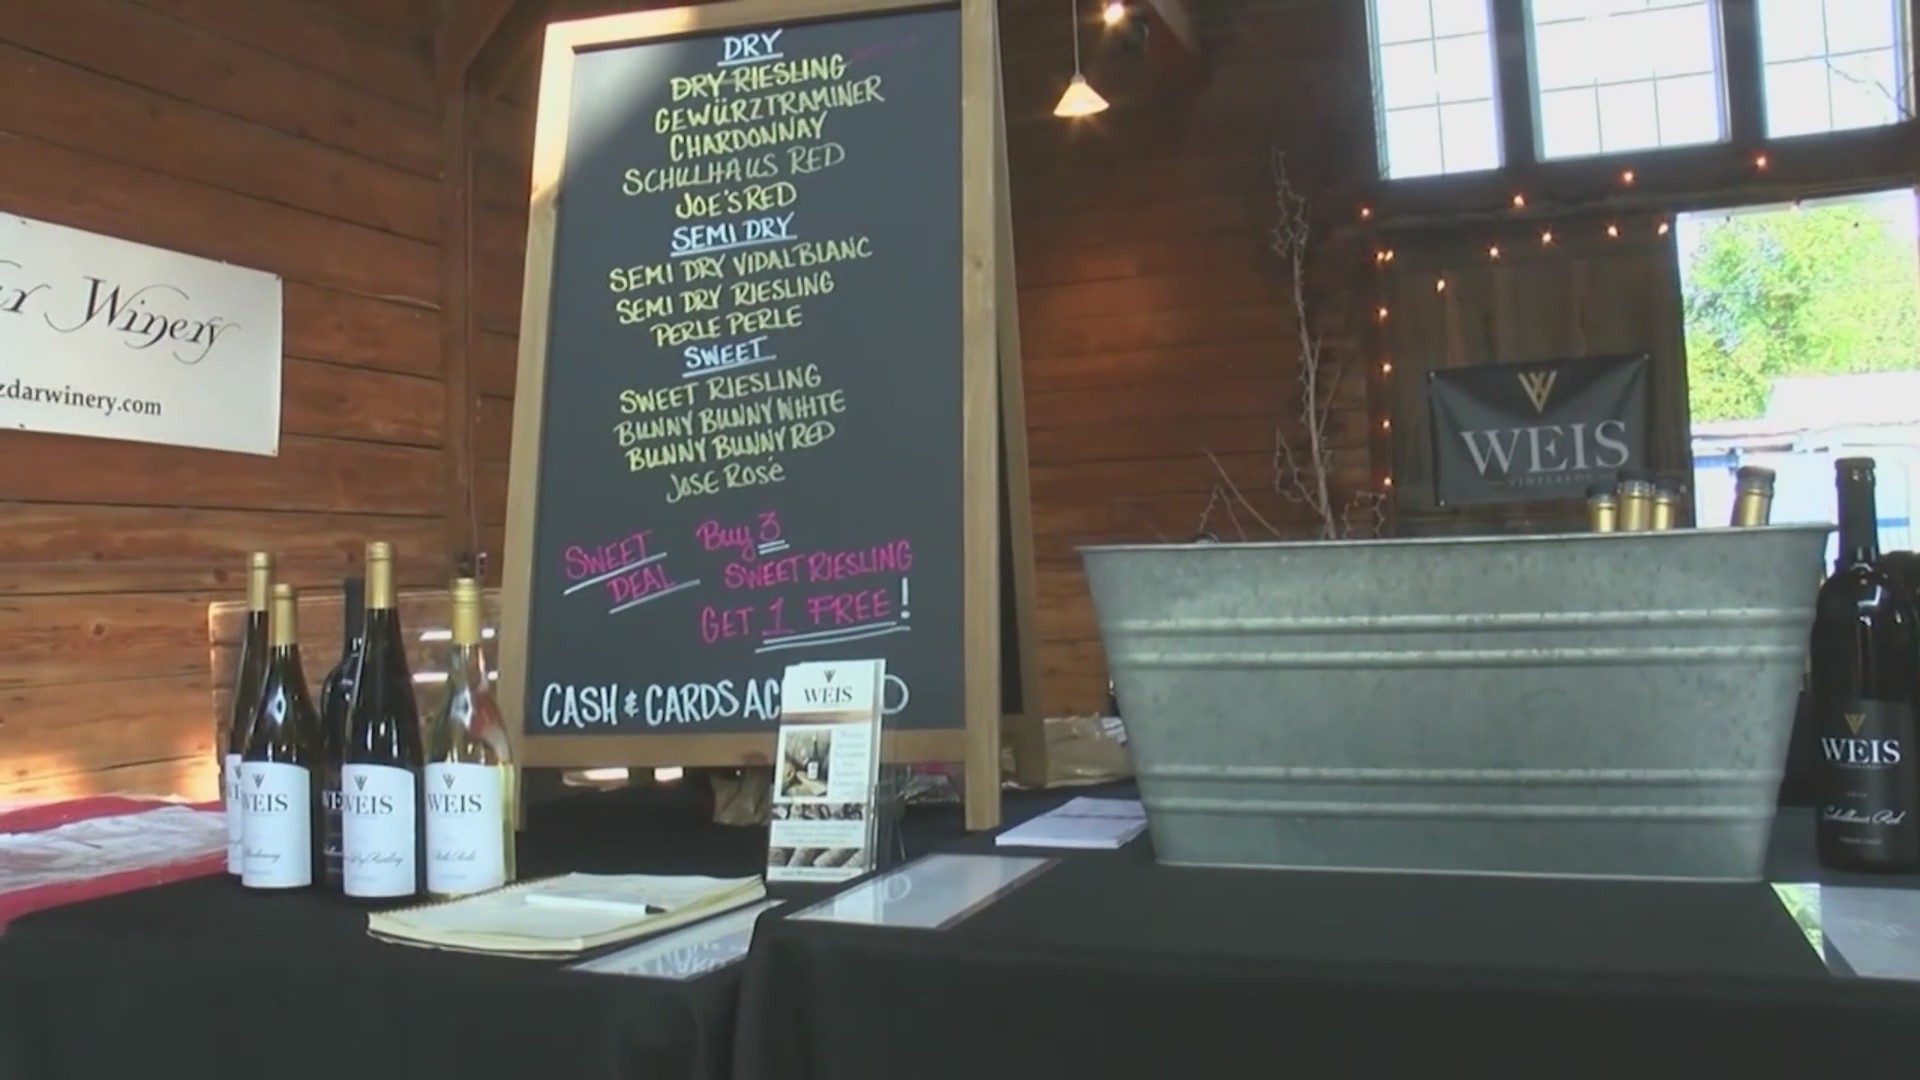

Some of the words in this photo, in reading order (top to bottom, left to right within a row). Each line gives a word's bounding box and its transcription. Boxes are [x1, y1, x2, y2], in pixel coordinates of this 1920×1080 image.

[724, 29, 783, 61] DRY
[671, 70, 726, 101] DRY
[733, 54, 847, 92] RIESLING
[670, 111, 828, 162] CHARDONNAY
[787, 142, 845, 175] RED
[675, 192, 742, 219] JOE'S
[745, 181, 797, 211] RED
[671, 223, 737, 252] SEMI
[744, 211, 795, 240] DRY
[609, 261, 674, 294] SEMI
[680, 254, 726, 284] DRY
[732, 247, 794, 277] VIDAL
[791, 236, 873, 267] BLANC
[44, 275, 242, 365] Winery
[615, 295, 674, 325] SEMI
[679, 284, 723, 314] DRY
[730, 270, 835, 307] RIESLING
[650, 317, 721, 348] PERLE
[725, 304, 803, 336] PERLE
[684, 335, 769, 370] SWEET
[618, 382, 700, 414] SWEET
[705, 363, 823, 400] RIESLING
[613, 410, 693, 448] BUNNY
[699, 399, 774, 436] BUNNY
[776, 389, 848, 422] WHITE
[624, 438, 707, 473] BUNNY
[711, 425, 787, 462] BUNNY
[790, 420, 837, 450] RED
[1459, 419, 1630, 477] WEIS
[757, 511, 783, 542] 3
[563, 529, 654, 581] SWEET
[724, 554, 808, 590] SWEET
[806, 539, 914, 583] RIESLING
[606, 564, 679, 604] DEAL
[701, 602, 756, 644] GET
[762, 595, 799, 637] 1
[542, 682, 620, 729] CASH
[623, 689, 640, 718] &
[645, 679, 741, 728] CARDS
[803, 686, 855, 705] WEIS
[1821, 737, 1901, 764] WEIS
[427, 793, 483, 813] WEIS
